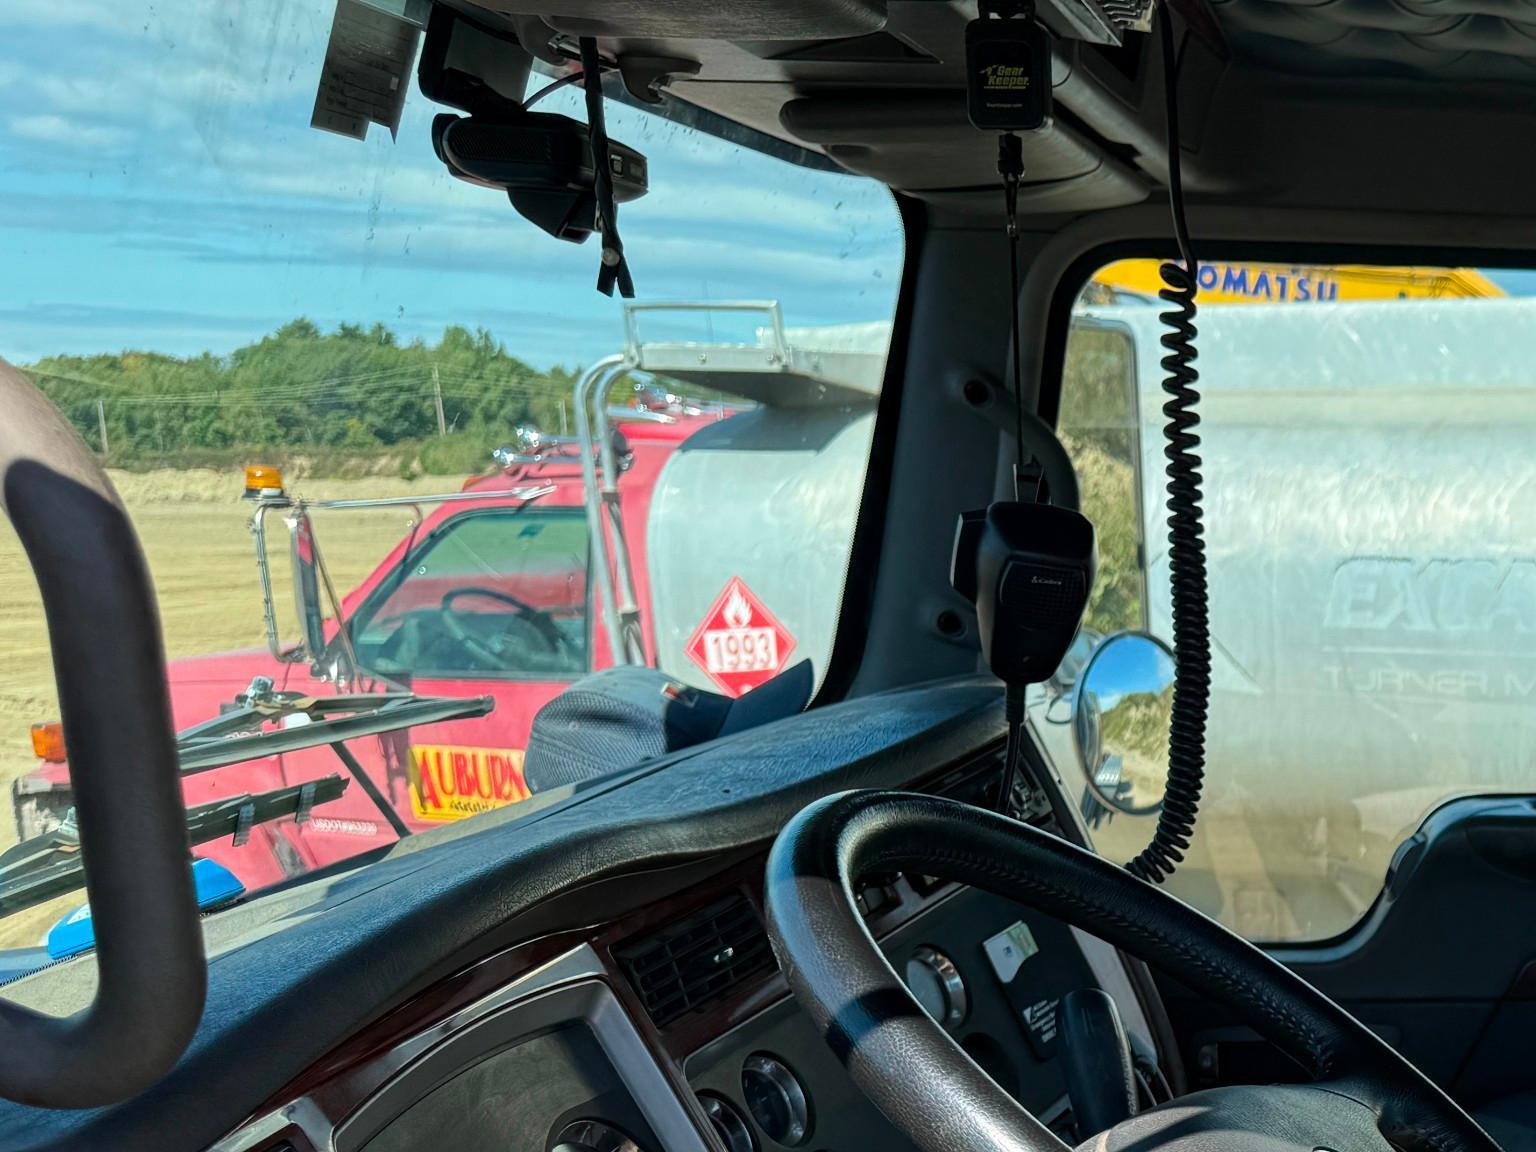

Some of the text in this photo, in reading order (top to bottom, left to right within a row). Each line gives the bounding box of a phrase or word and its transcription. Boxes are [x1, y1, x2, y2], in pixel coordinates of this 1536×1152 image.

[997, 65, 1025, 76] Gear
[1196, 265, 1338, 301] OMATSU
[711, 633, 772, 671] 1993
